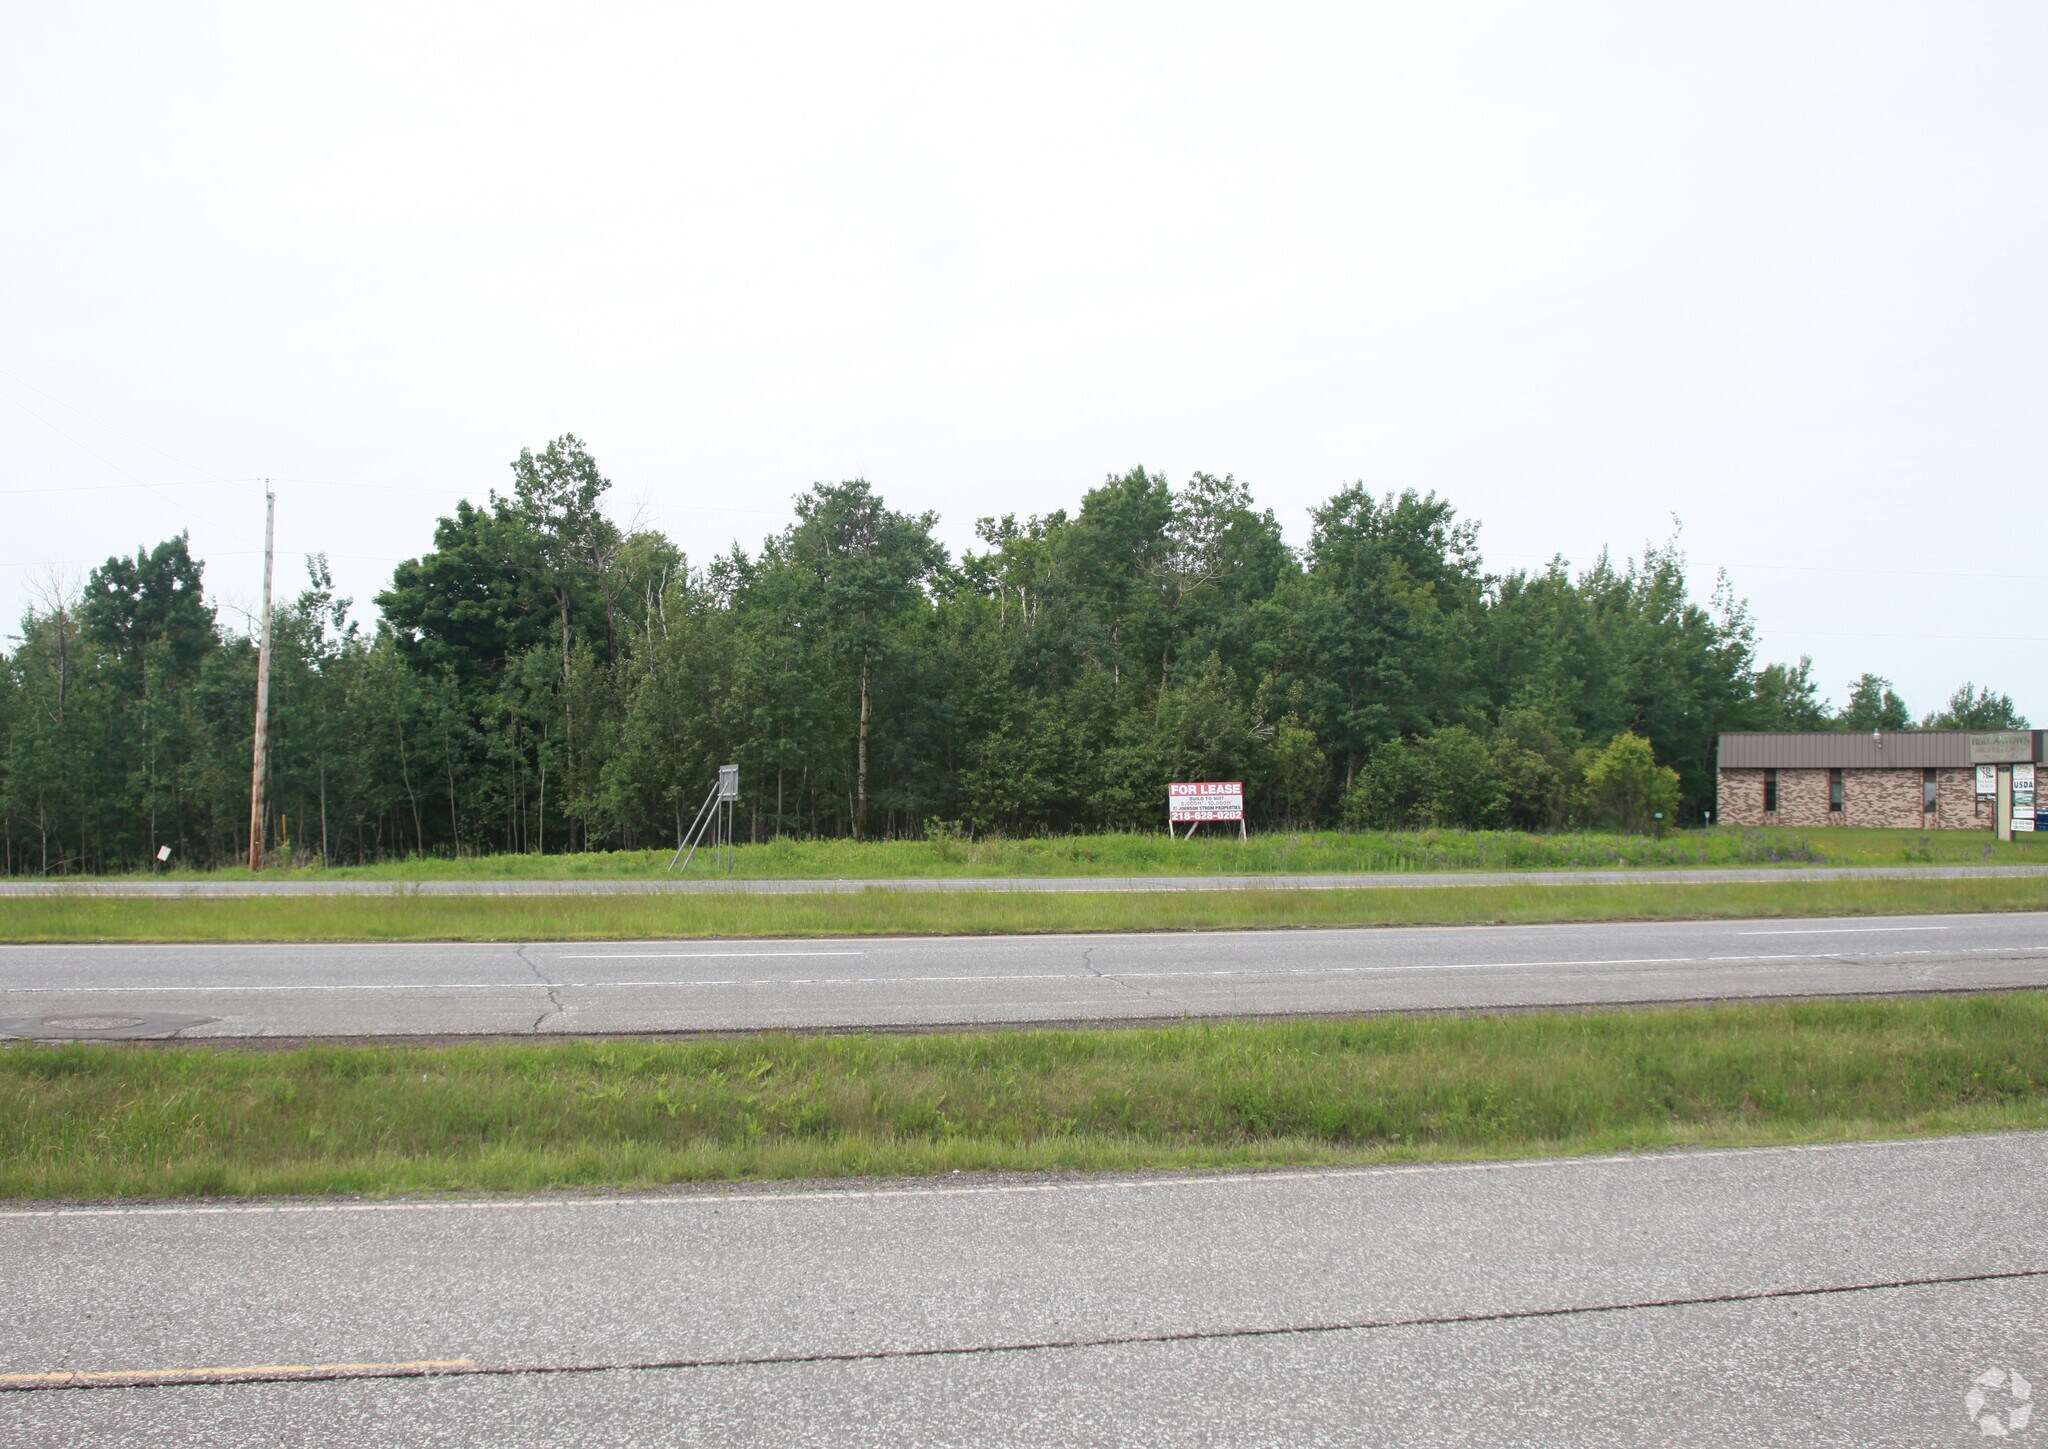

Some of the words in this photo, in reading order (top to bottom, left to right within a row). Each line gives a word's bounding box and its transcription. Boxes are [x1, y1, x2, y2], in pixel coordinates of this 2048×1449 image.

[1171, 784, 1197, 794] FOR
[1201, 784, 1241, 794] LEASE
[1172, 811, 1242, 820] 218-628-0202
